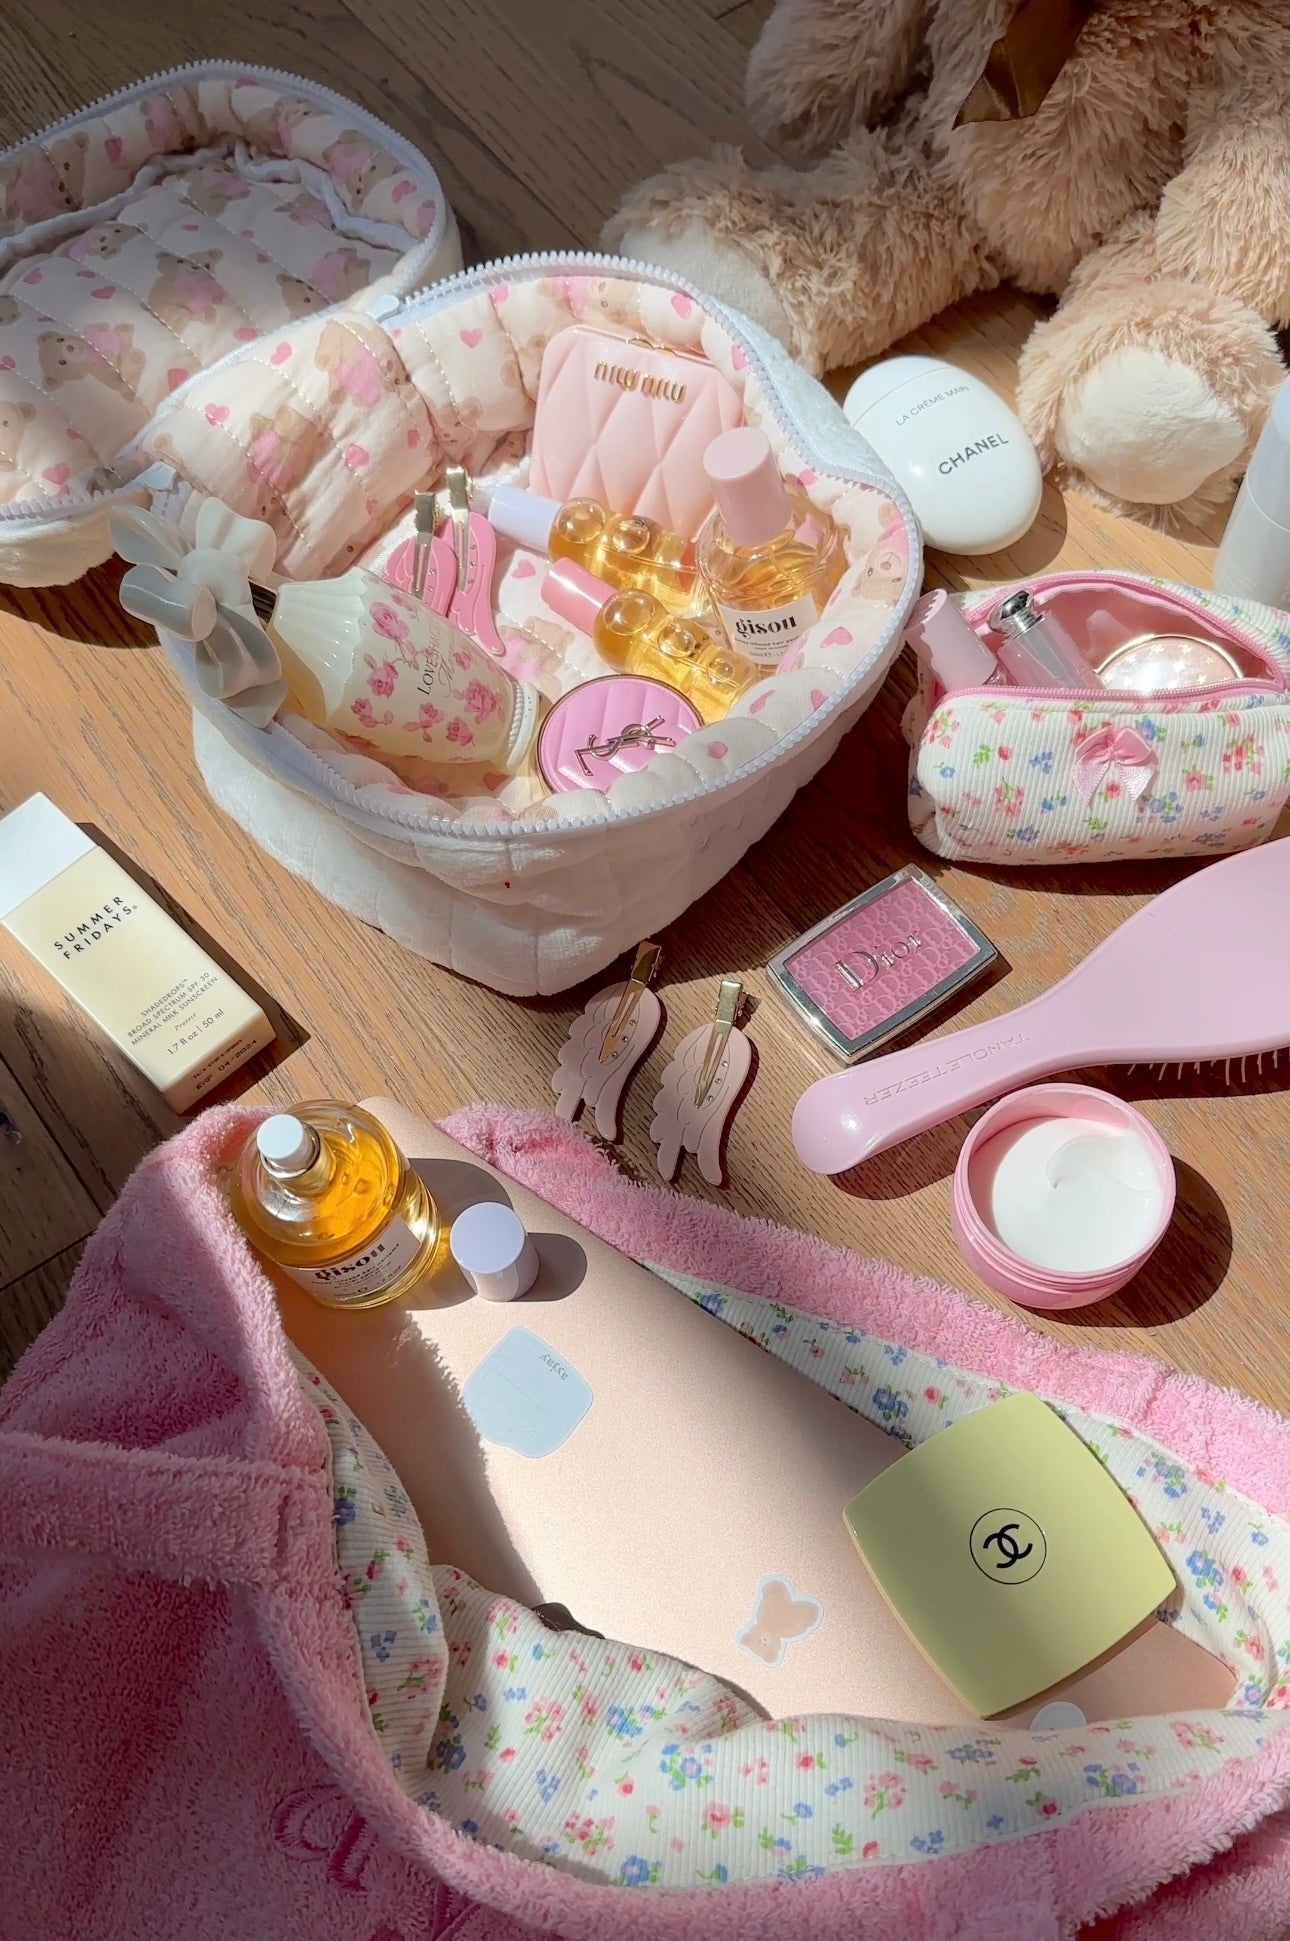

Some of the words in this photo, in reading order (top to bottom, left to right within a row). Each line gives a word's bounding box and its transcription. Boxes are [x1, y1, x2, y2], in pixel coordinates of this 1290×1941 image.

[896, 415, 910, 426] LA
[944, 385, 970, 396] MAIN
[938, 434, 1009, 475] CHANEL
[735, 616, 797, 640] gisou
[54, 896, 124, 950] SUMMER
[832, 930, 922, 993] Dior
[127, 1018, 152, 1039] BROAD
[152, 991, 188, 1020] SPECTRUM
[187, 981, 199, 993] SPF
[199, 972, 210, 982] 30
[131, 1022, 162, 1046] MINERAL
[162, 1009, 180, 1024] MILK
[178, 976, 219, 1011] SUNSCREEN
[167, 1042, 179, 1055] 1.7
[179, 1038, 188, 1046] fl
[187, 1030, 199, 1041] oz
[202, 1017, 214, 1029] 50
[214, 1008, 225, 1020] ml
